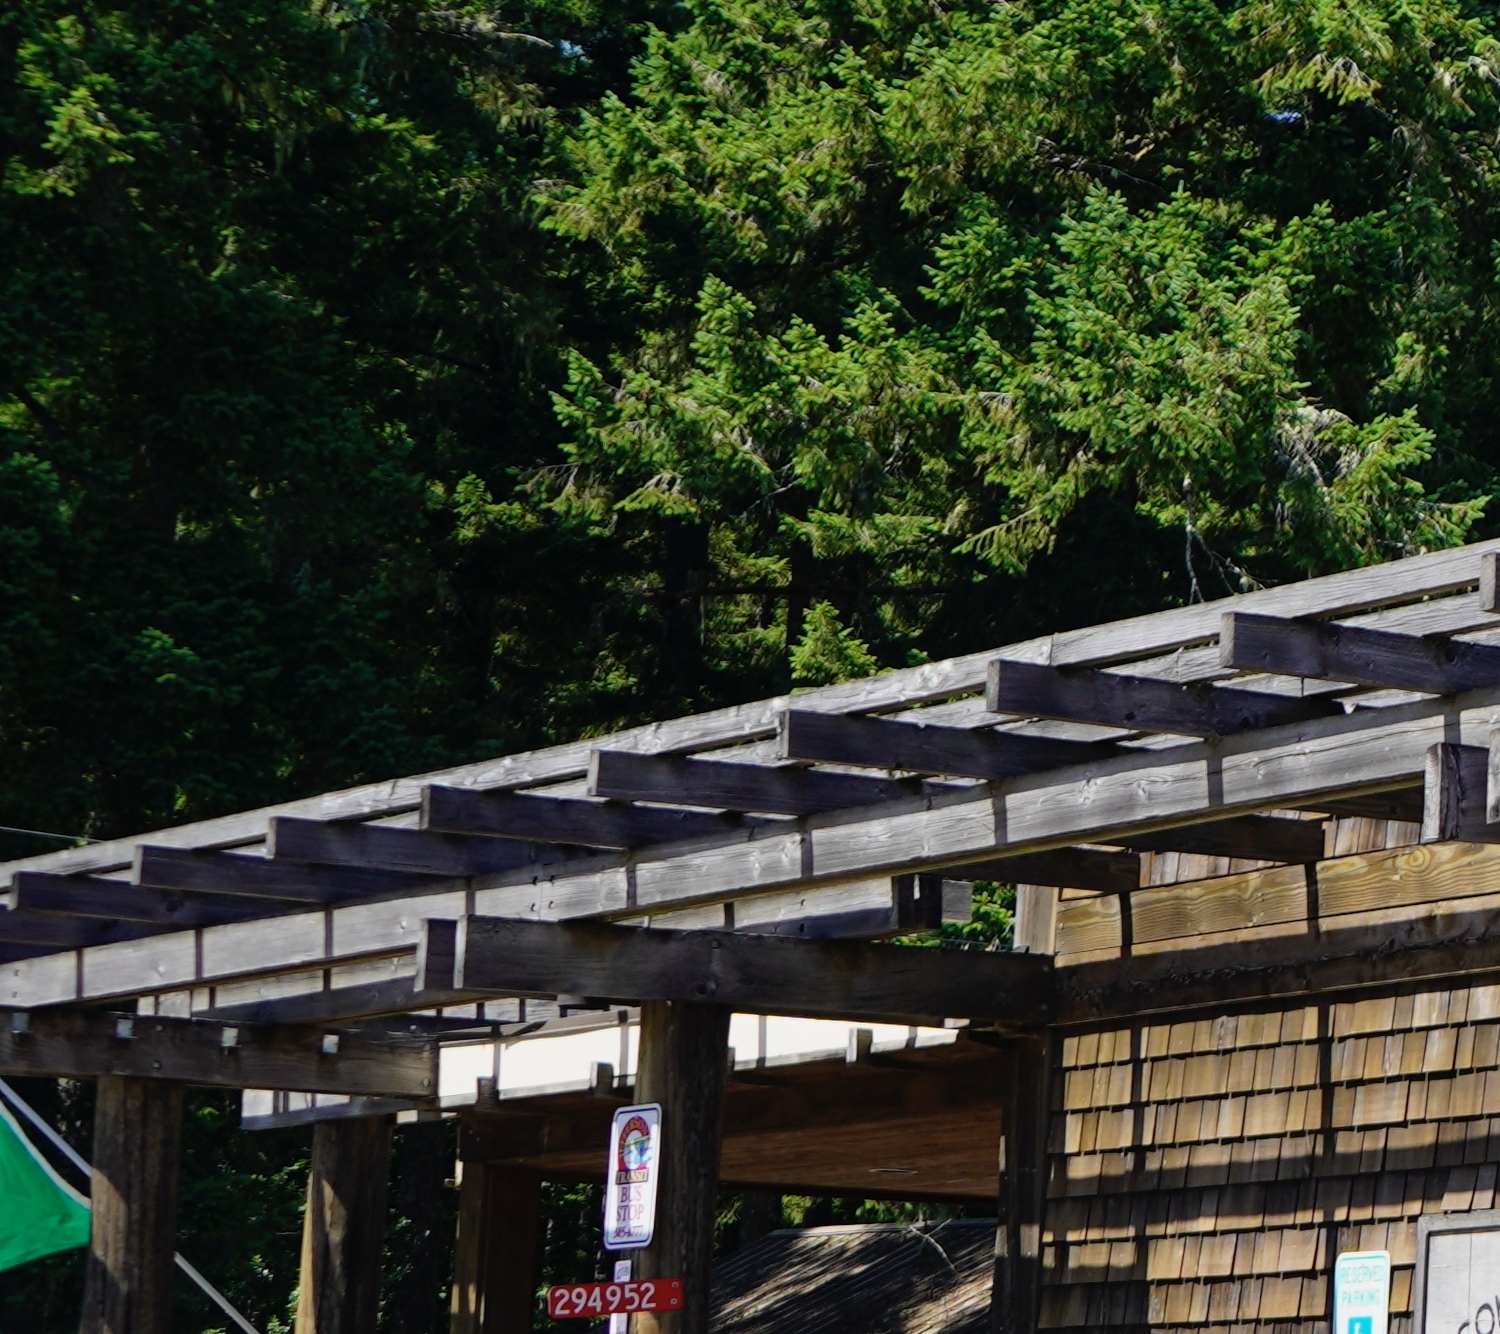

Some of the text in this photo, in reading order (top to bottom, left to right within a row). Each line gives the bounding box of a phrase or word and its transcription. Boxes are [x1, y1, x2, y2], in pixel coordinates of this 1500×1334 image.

[616, 1170, 647, 1183] TRANSIT
[620, 1184, 642, 1202] BUS
[616, 1204, 644, 1222] STOP
[1340, 1265, 1384, 1284] RESERVED
[554, 1282, 657, 1315] 294952
[1341, 1289, 1380, 1307] PARKING
